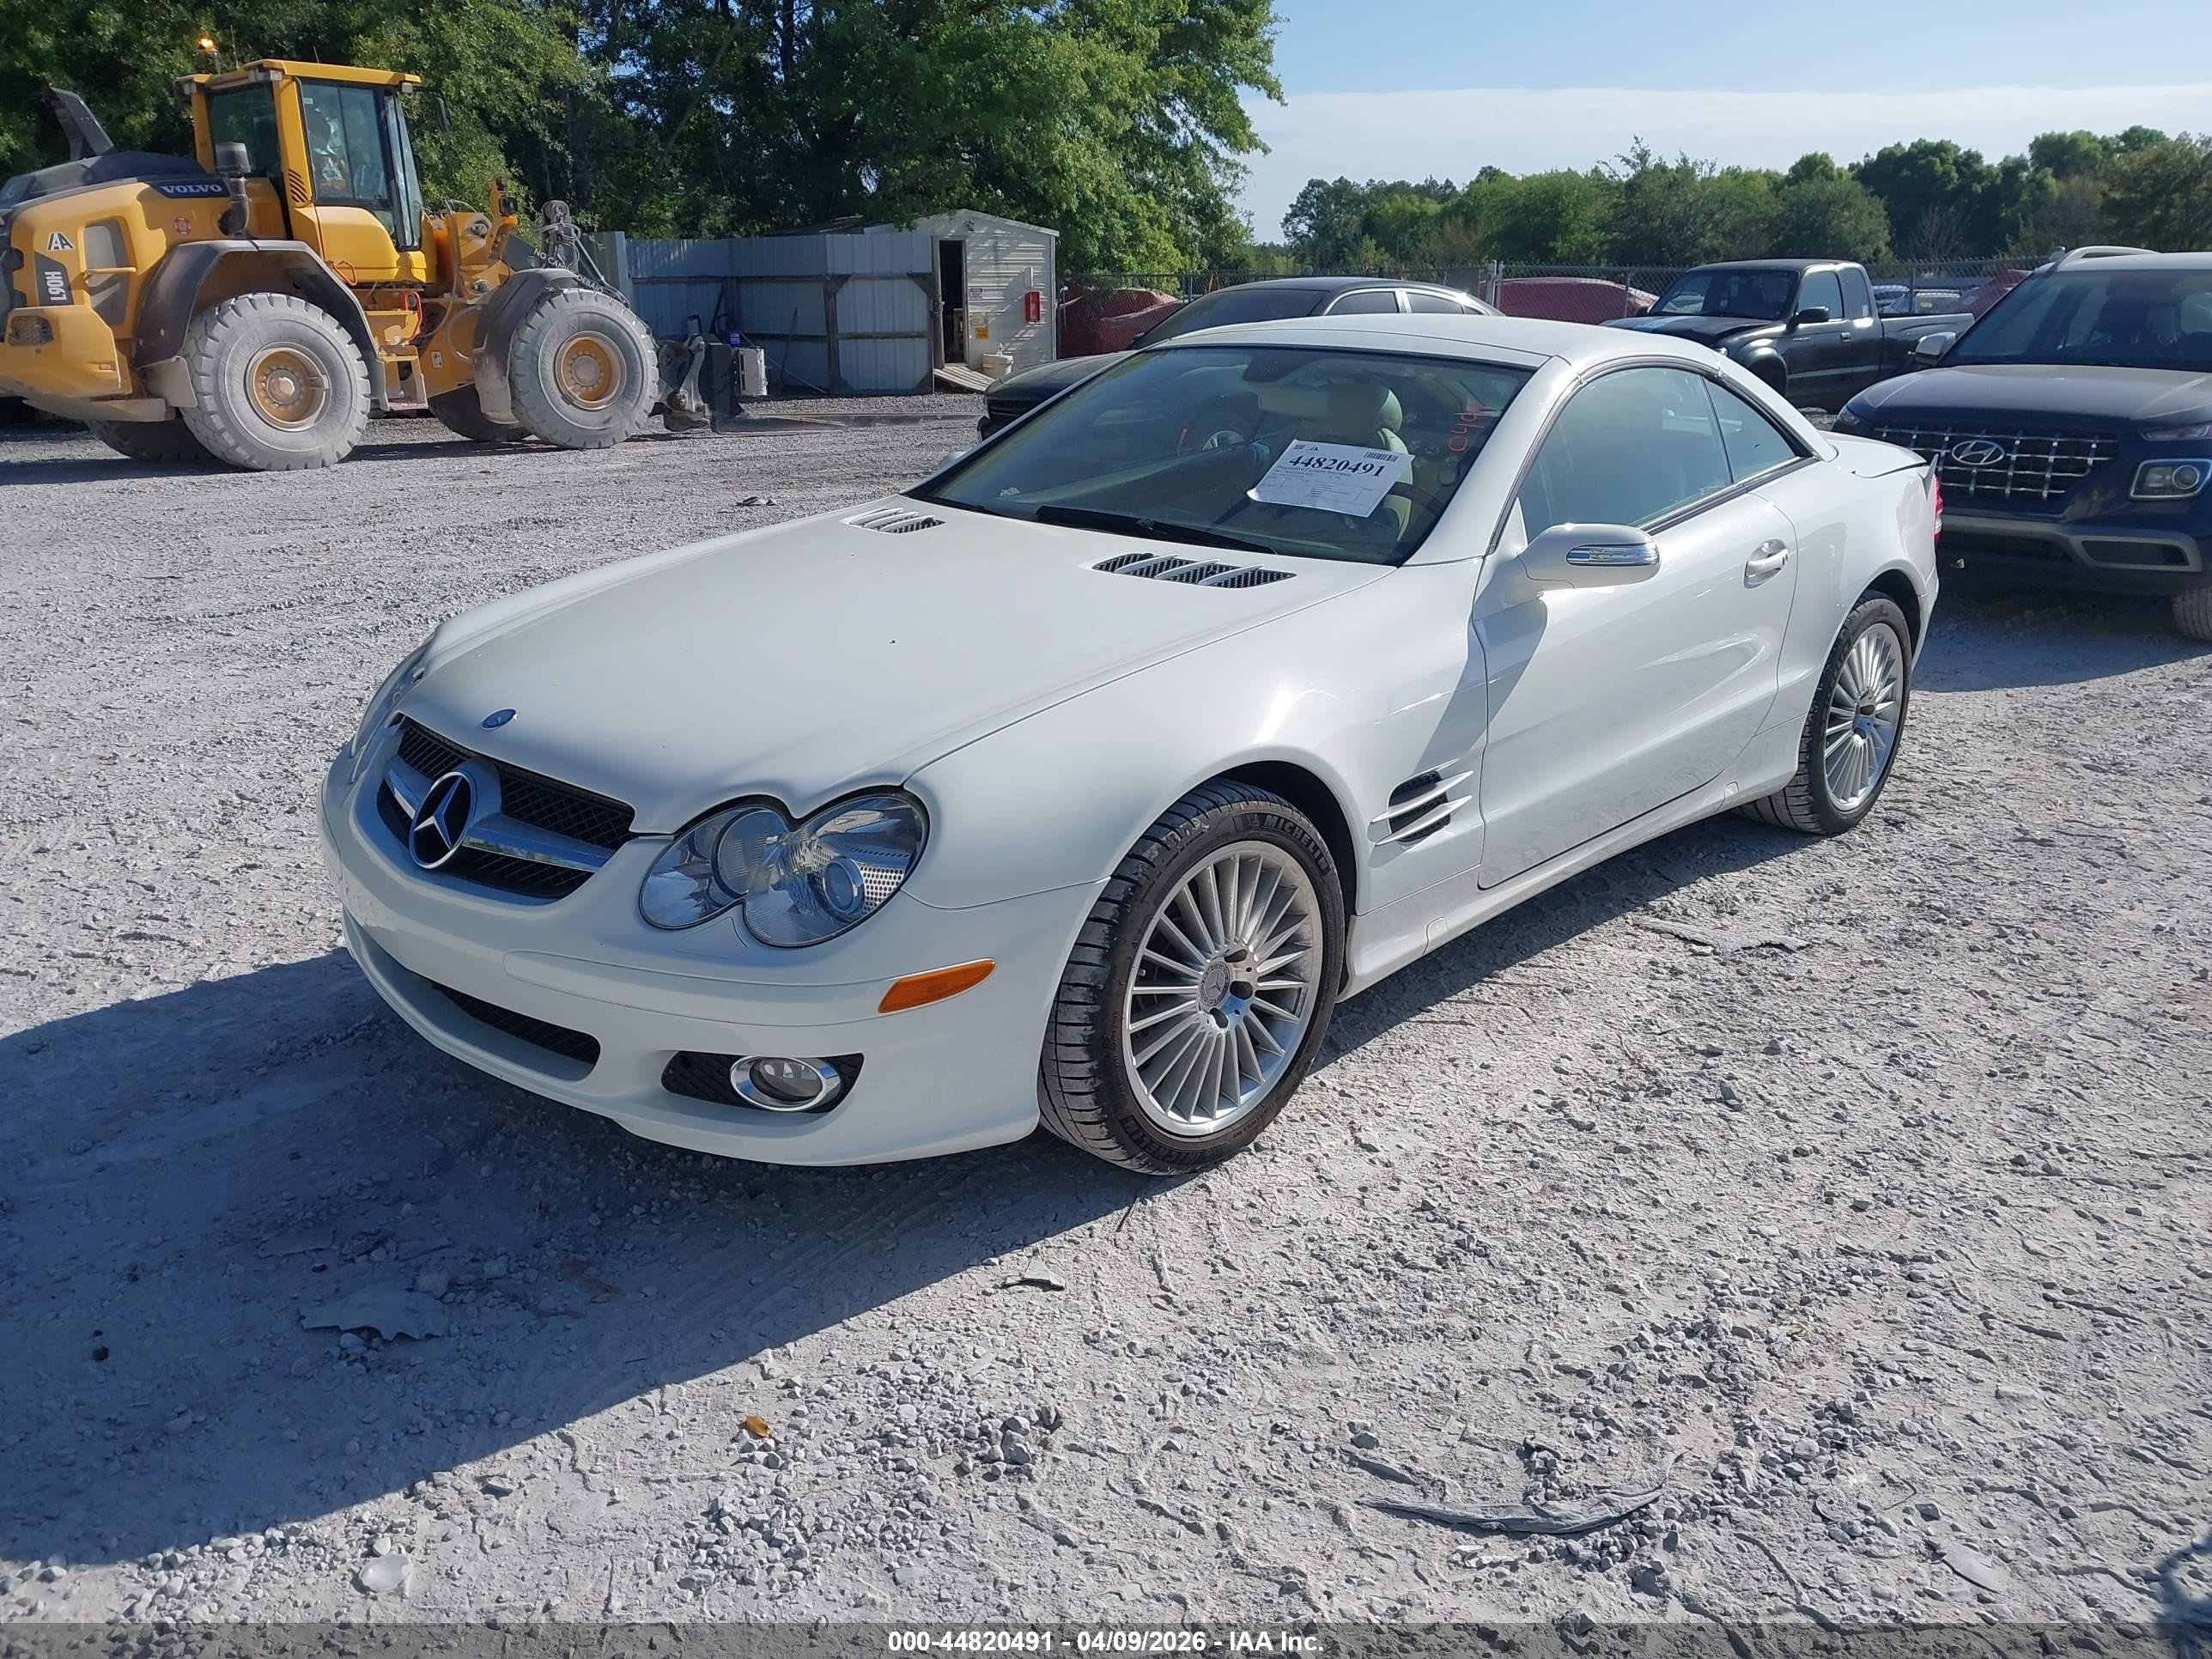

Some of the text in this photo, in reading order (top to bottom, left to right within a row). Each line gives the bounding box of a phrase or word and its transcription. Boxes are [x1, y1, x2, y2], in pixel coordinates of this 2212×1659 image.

[160, 184, 222, 193] VOLVO
[533, 247, 547, 259] NO
[45, 271, 67, 301] L90H
[1289, 455, 1385, 477] 44820491
[1264, 814, 1328, 872] MICHELIN
